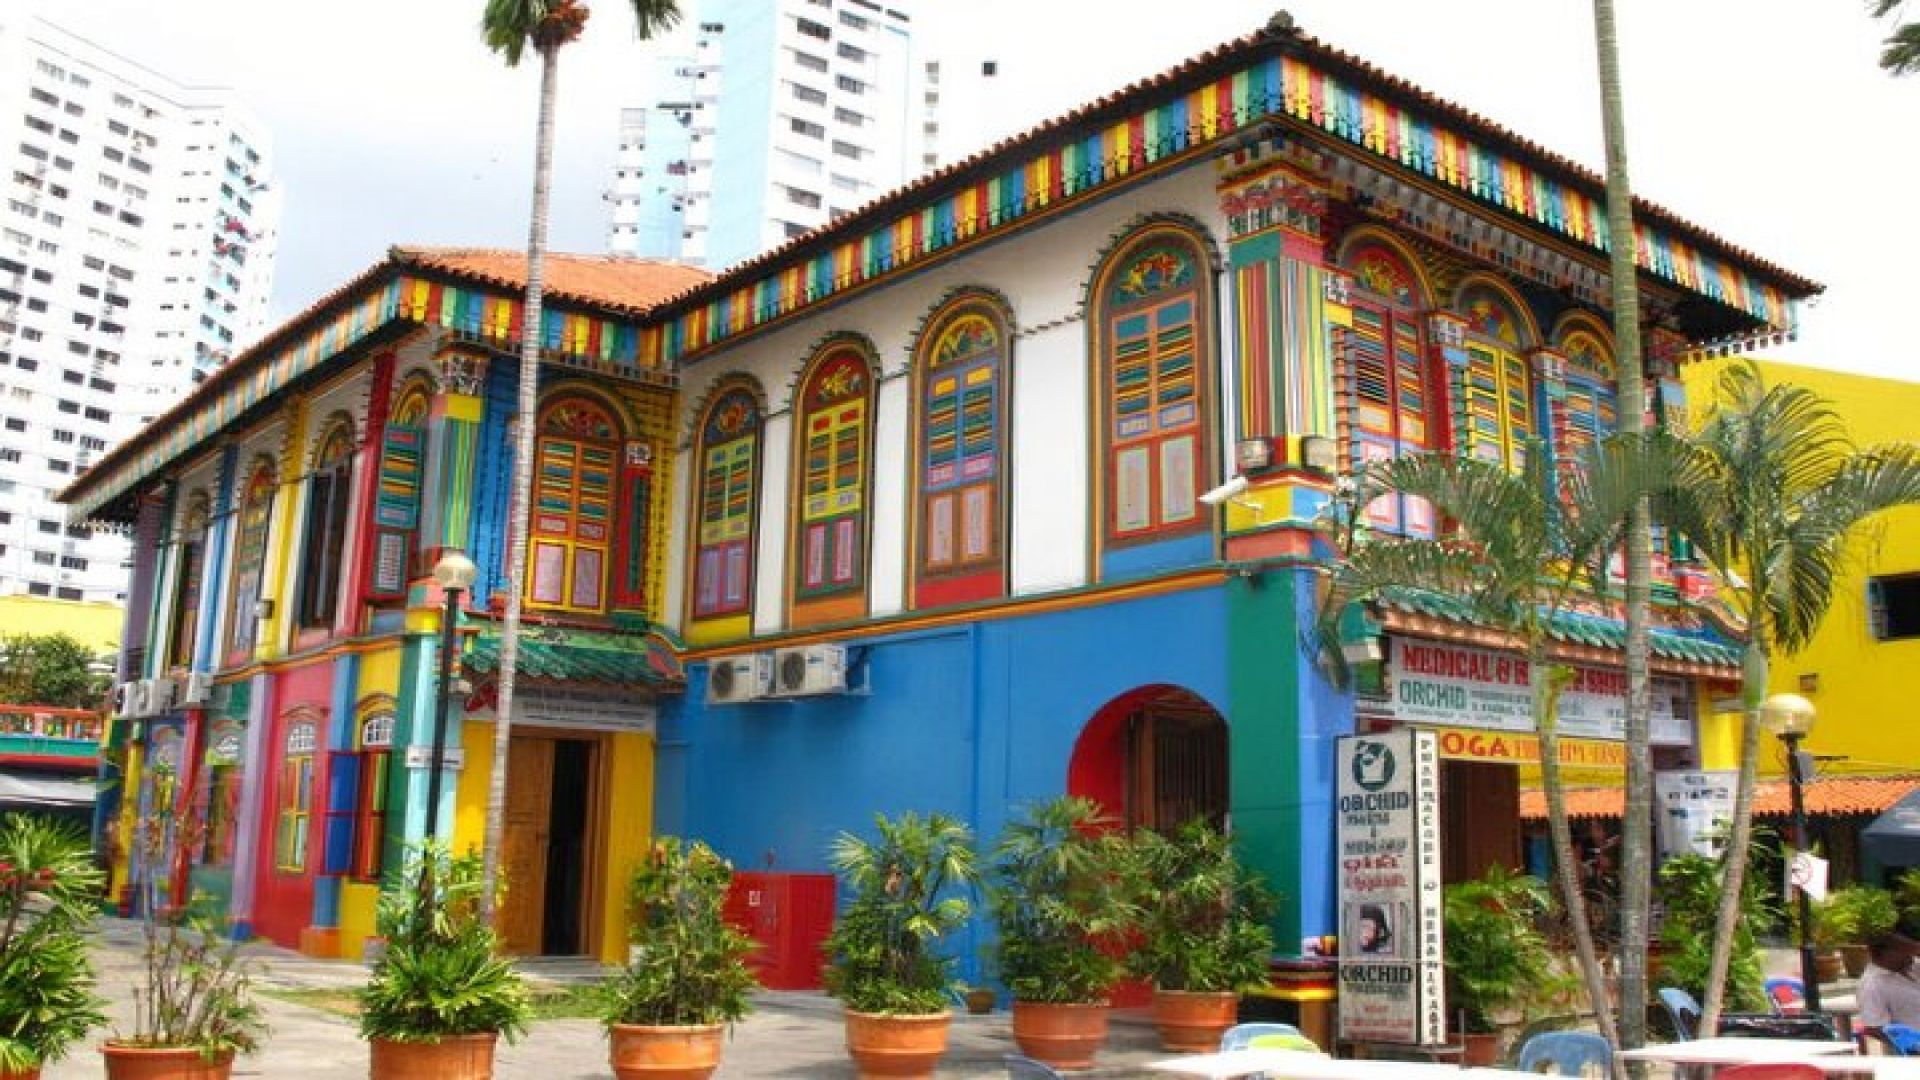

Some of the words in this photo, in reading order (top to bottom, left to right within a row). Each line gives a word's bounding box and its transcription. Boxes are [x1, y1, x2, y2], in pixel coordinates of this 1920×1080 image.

[1403, 645, 1494, 683] MEDICAL
[1399, 680, 1466, 710] ORCHID
[1341, 791, 1409, 813] ORCHID
[1341, 965, 1412, 983] ORCHID
